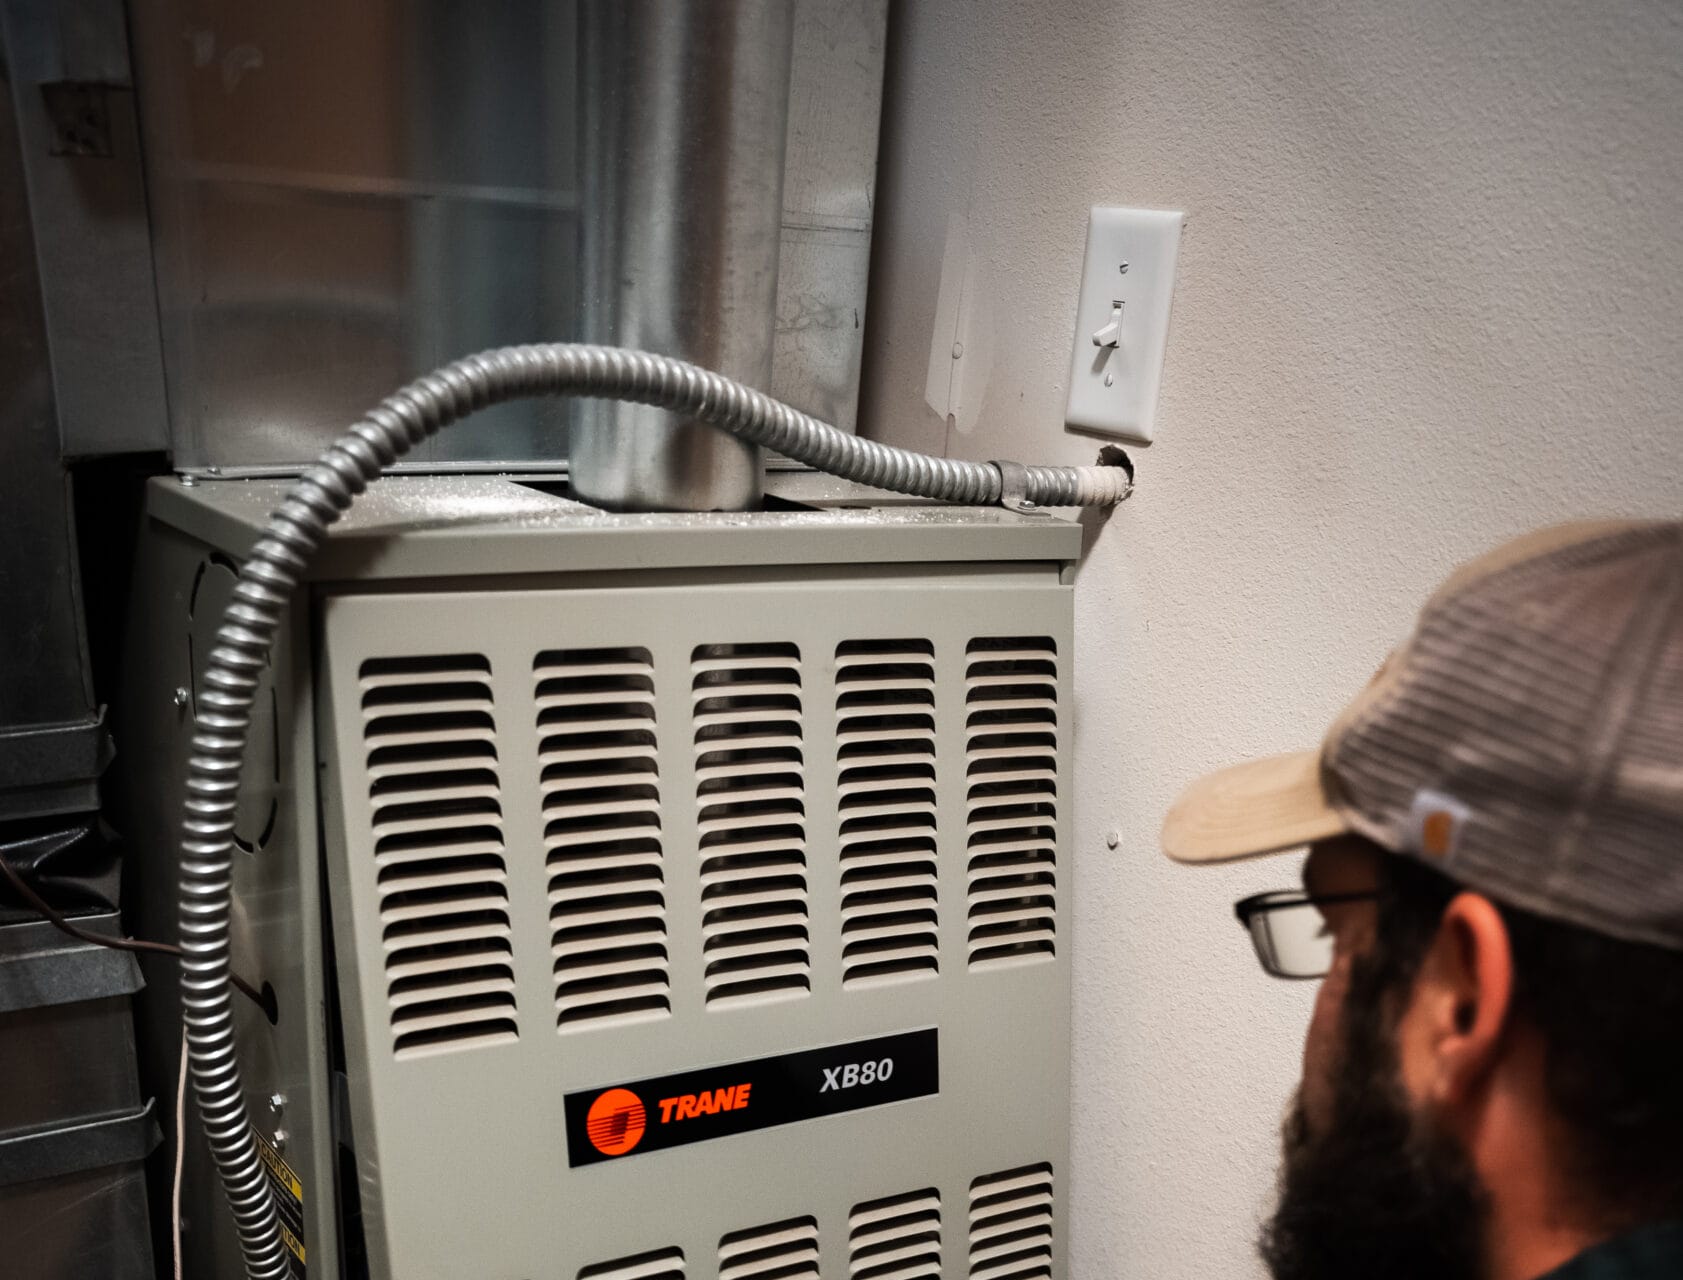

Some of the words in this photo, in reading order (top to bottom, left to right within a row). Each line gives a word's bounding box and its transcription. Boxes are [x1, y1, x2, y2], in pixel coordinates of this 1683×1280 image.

[658, 1083, 752, 1125] TRANE
[819, 1057, 894, 1094] XB80
[261, 1143, 293, 1190] CAUTION
